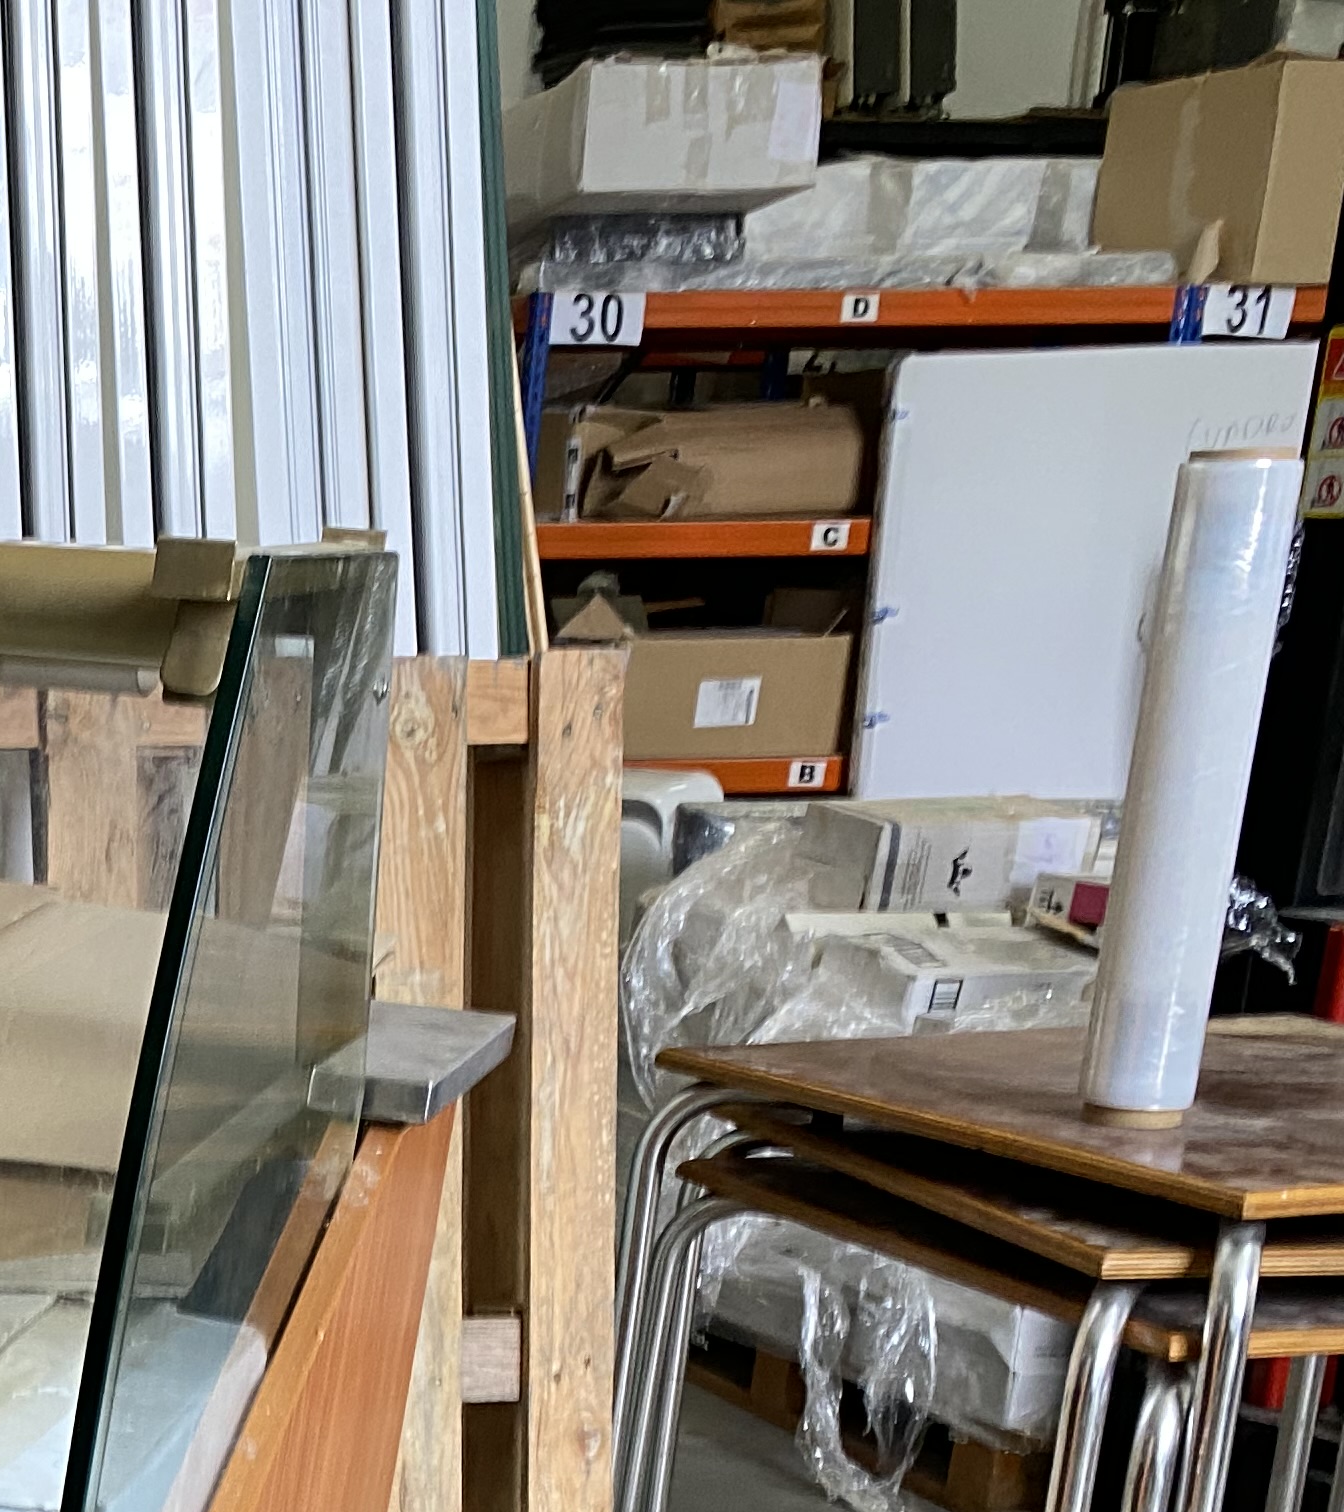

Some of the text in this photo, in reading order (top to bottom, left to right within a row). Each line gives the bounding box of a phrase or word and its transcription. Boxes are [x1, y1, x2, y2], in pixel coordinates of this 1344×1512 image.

[569, 293, 624, 342] 30
[853, 297, 870, 318] D
[1226, 284, 1272, 335] 31
[823, 527, 839, 547] C
[799, 764, 815, 784] B
